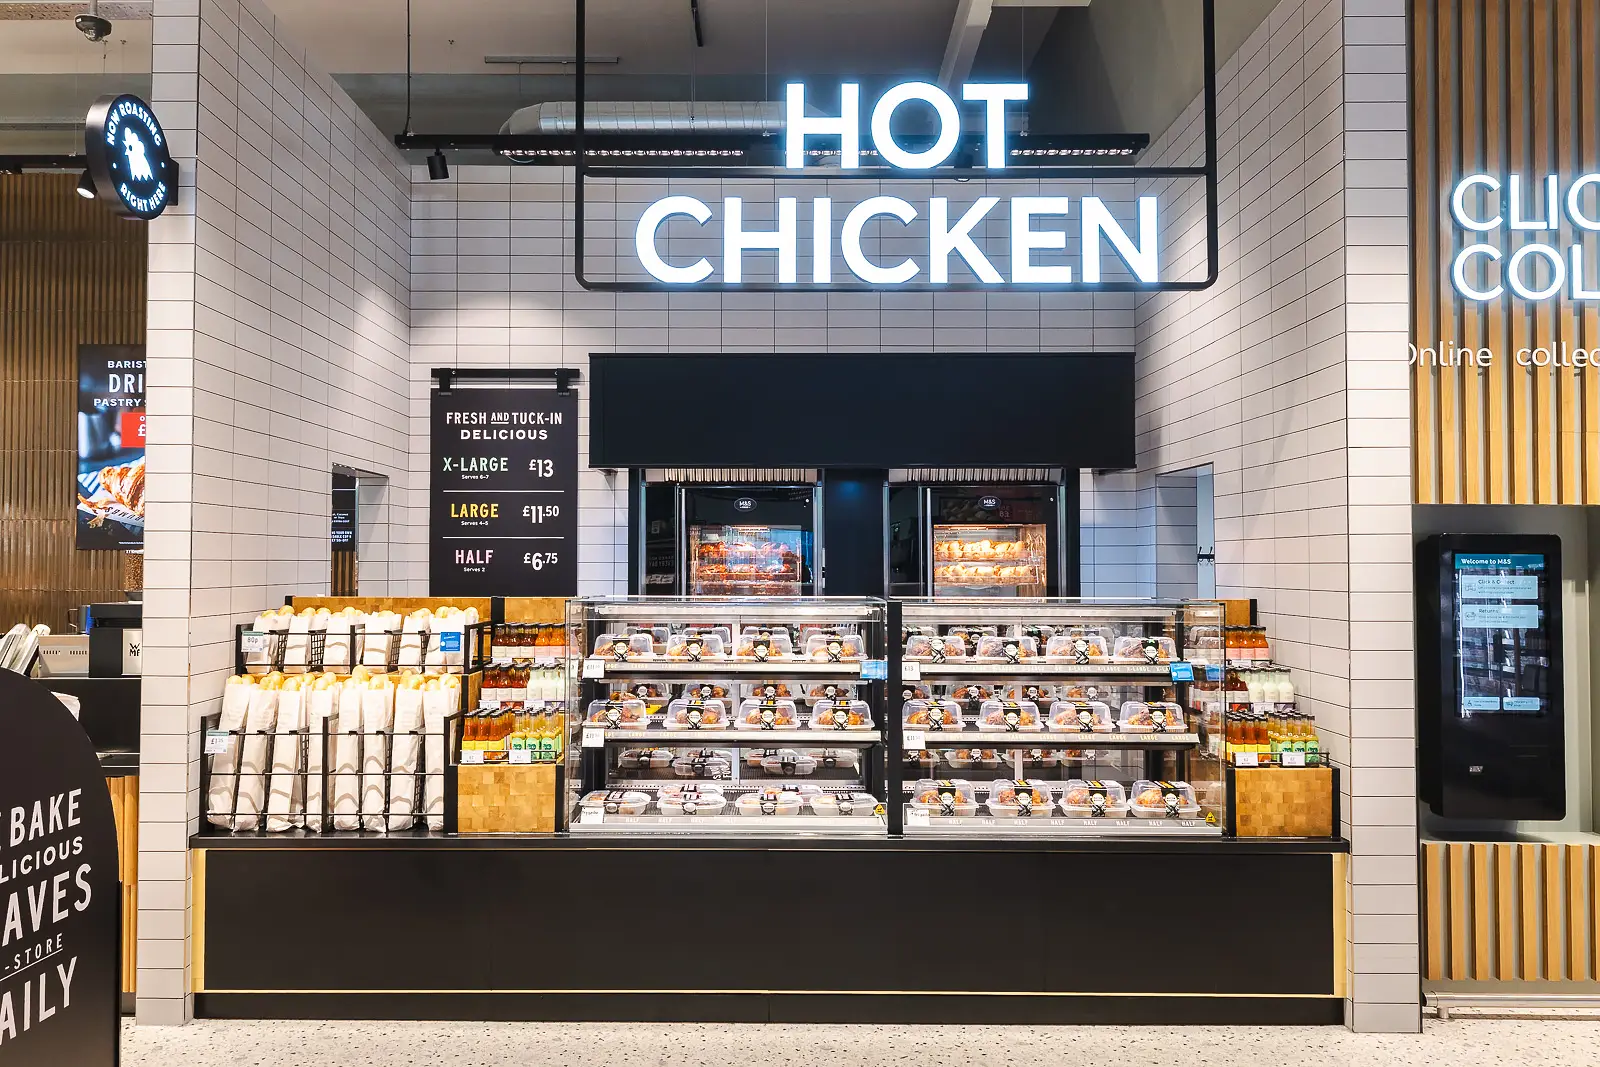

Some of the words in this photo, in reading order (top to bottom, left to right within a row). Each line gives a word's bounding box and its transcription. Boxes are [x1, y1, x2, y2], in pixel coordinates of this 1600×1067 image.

[106, 109, 121, 146] NOW
[118, 101, 162, 146] ROASTING
[785, 81, 1030, 169] HOT
[120, 182, 148, 212] RIGHT
[149, 181, 166, 210] HERE
[635, 195, 1159, 284] CHICKEN
[93, 398, 142, 407] PASTRY
[446, 411, 487, 425] FRESH
[490, 411, 510, 423] AND
[512, 411, 563, 425] TUCK-IN
[460, 429, 549, 440] DELICIOUS
[442, 457, 509, 472] X-LARGE
[528, 459, 554, 478] £13
[451, 503, 499, 518] LARGE
[522, 505, 560, 524] £11.50
[455, 549, 494, 564] HALF
[523, 552, 559, 571] £6.75
[9, 788, 82, 848] BAKE
[1, 863, 92, 947] AVES
[0, 956, 78, 1046] AILY
